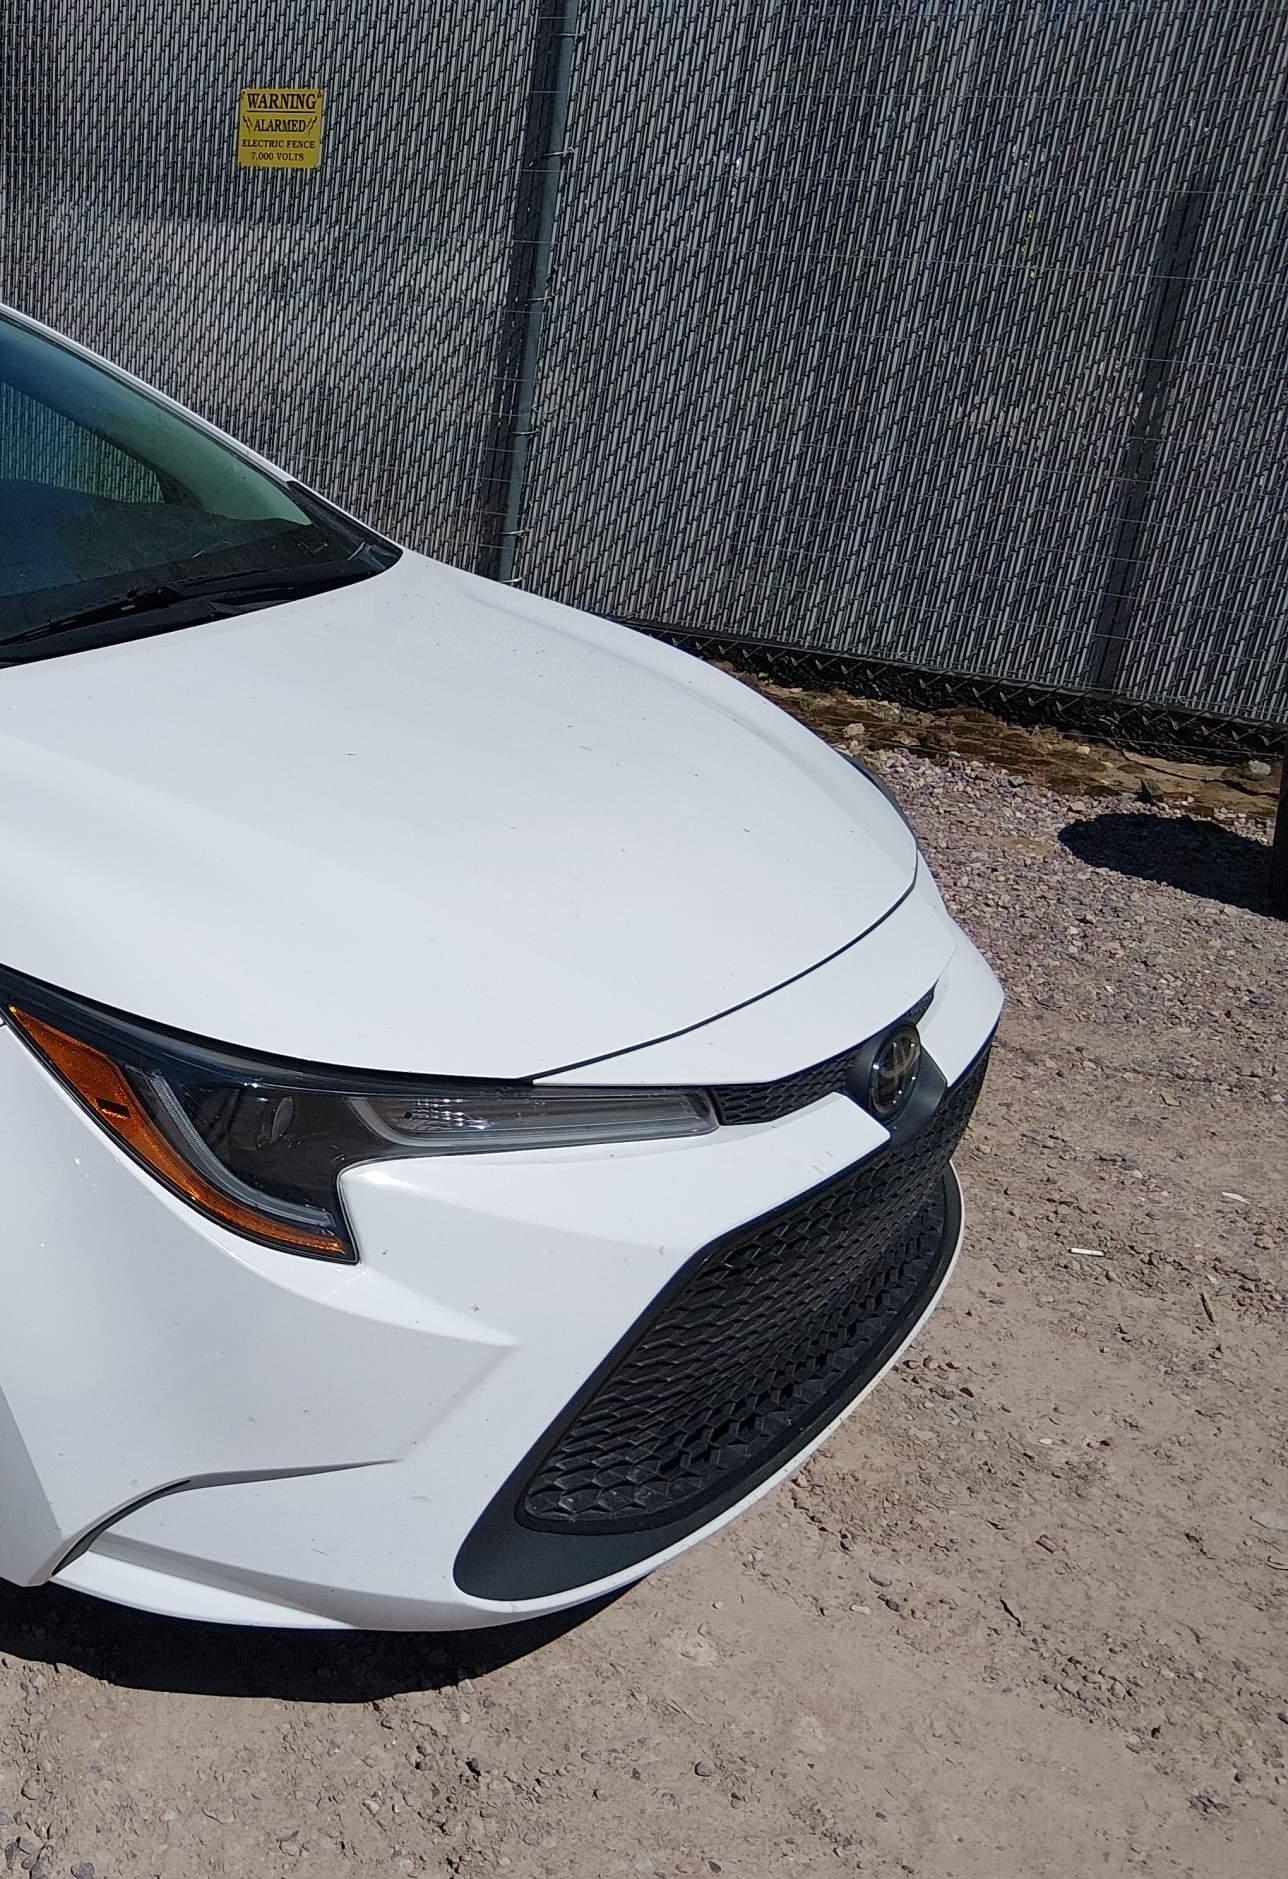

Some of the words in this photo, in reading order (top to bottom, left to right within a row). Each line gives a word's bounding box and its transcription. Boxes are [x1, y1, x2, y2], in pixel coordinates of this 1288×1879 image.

[247, 93, 317, 110] WARNING
[253, 119, 307, 132] ALARMED
[241, 139, 284, 148] ELECTRIC
[286, 140, 316, 149] FENCE
[251, 152, 274, 161] 7,000
[276, 152, 304, 161] VOLTS
